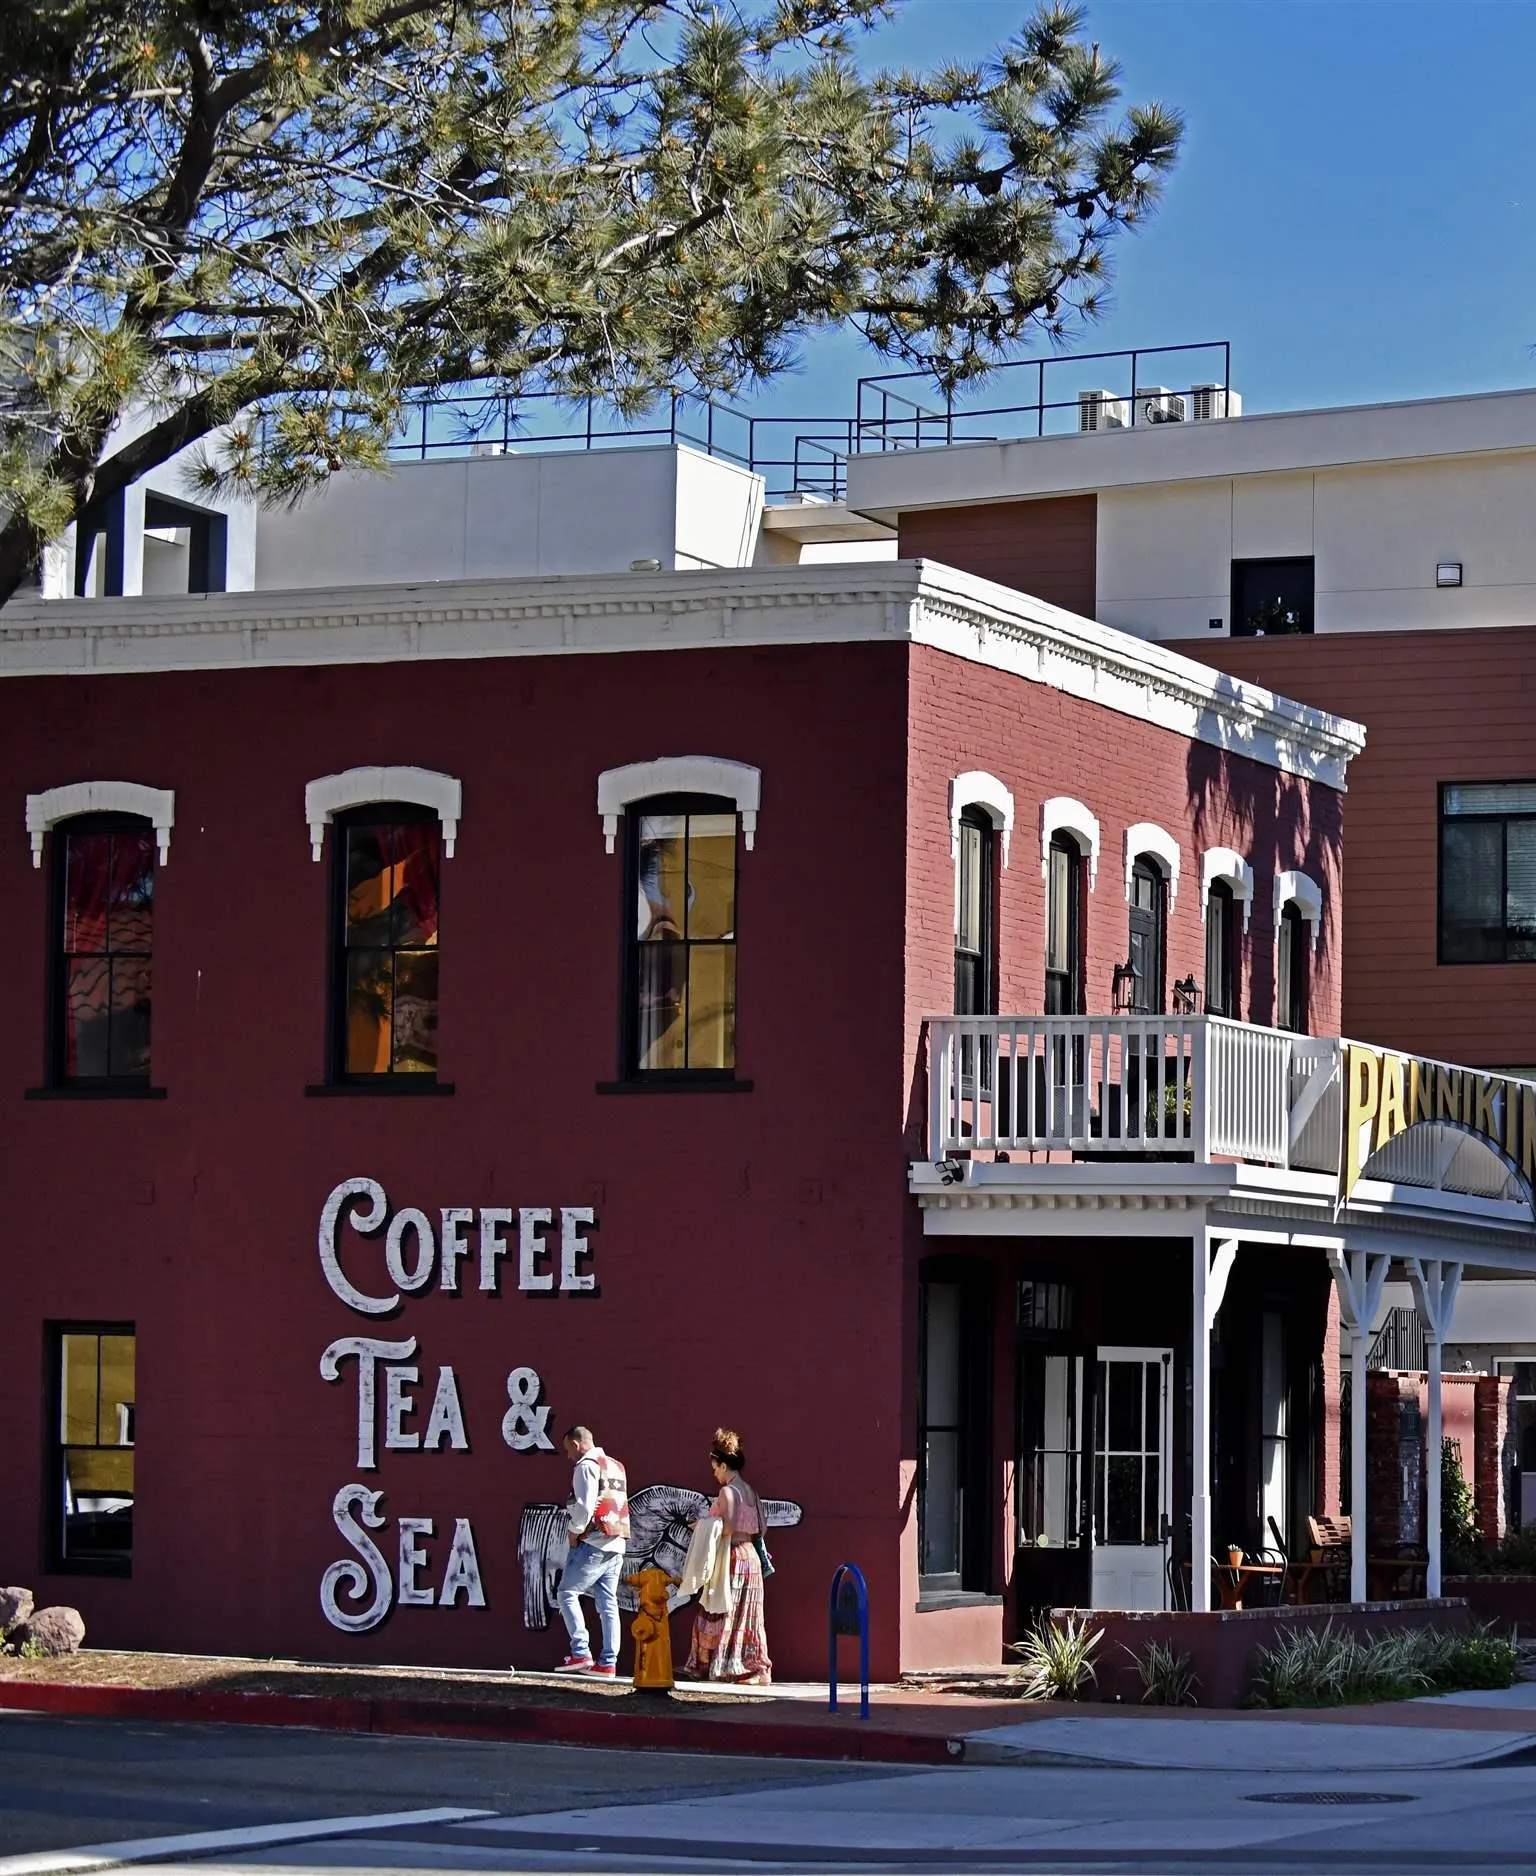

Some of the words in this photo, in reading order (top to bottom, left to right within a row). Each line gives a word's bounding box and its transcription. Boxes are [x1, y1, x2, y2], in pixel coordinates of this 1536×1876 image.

[319, 1177, 597, 1314] COFFEE
[320, 1336, 469, 1469] TEA
[502, 1367, 555, 1451] &
[320, 1483, 487, 1633] SEA
